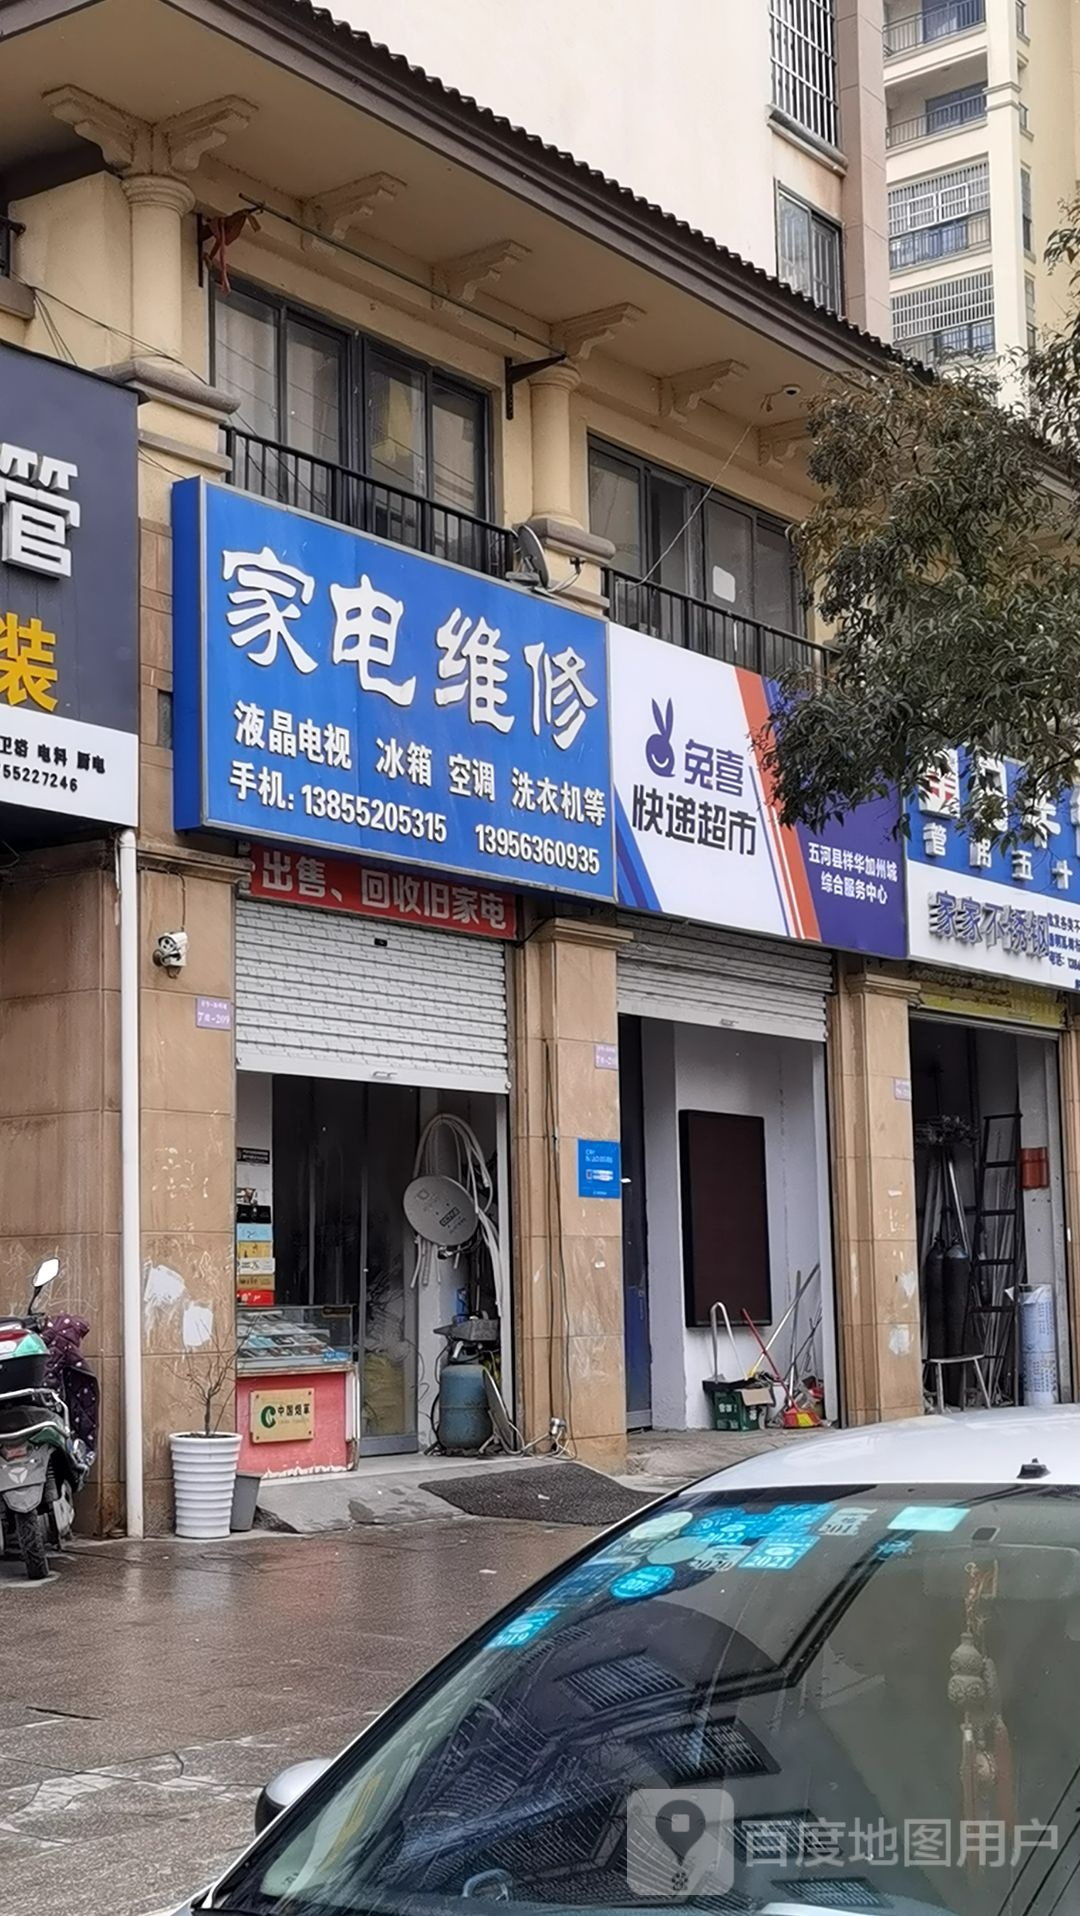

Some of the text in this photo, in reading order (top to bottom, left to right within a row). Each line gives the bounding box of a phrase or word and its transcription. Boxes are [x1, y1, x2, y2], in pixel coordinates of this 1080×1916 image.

[0, 442, 80, 580] 管
[0, 612, 58, 712] 装
[221, 546, 599, 751] 家电维修
[234, 699, 606, 827] 液晶电视 冰箱 空调 洗衣机等
[301, 784, 448, 842] 13855205315
[475, 824, 600, 875] 13956360935
[632, 784, 757, 857] 快递超市
[261, 850, 507, 931] 出售、回收旧家电
[807, 842, 898, 883] 五河县祥华加州城
[820, 871, 889, 905] 综合服务中心
[928, 890, 1050, 959] 家家不锈钢
[744, 1555, 794, 1568] 2021
